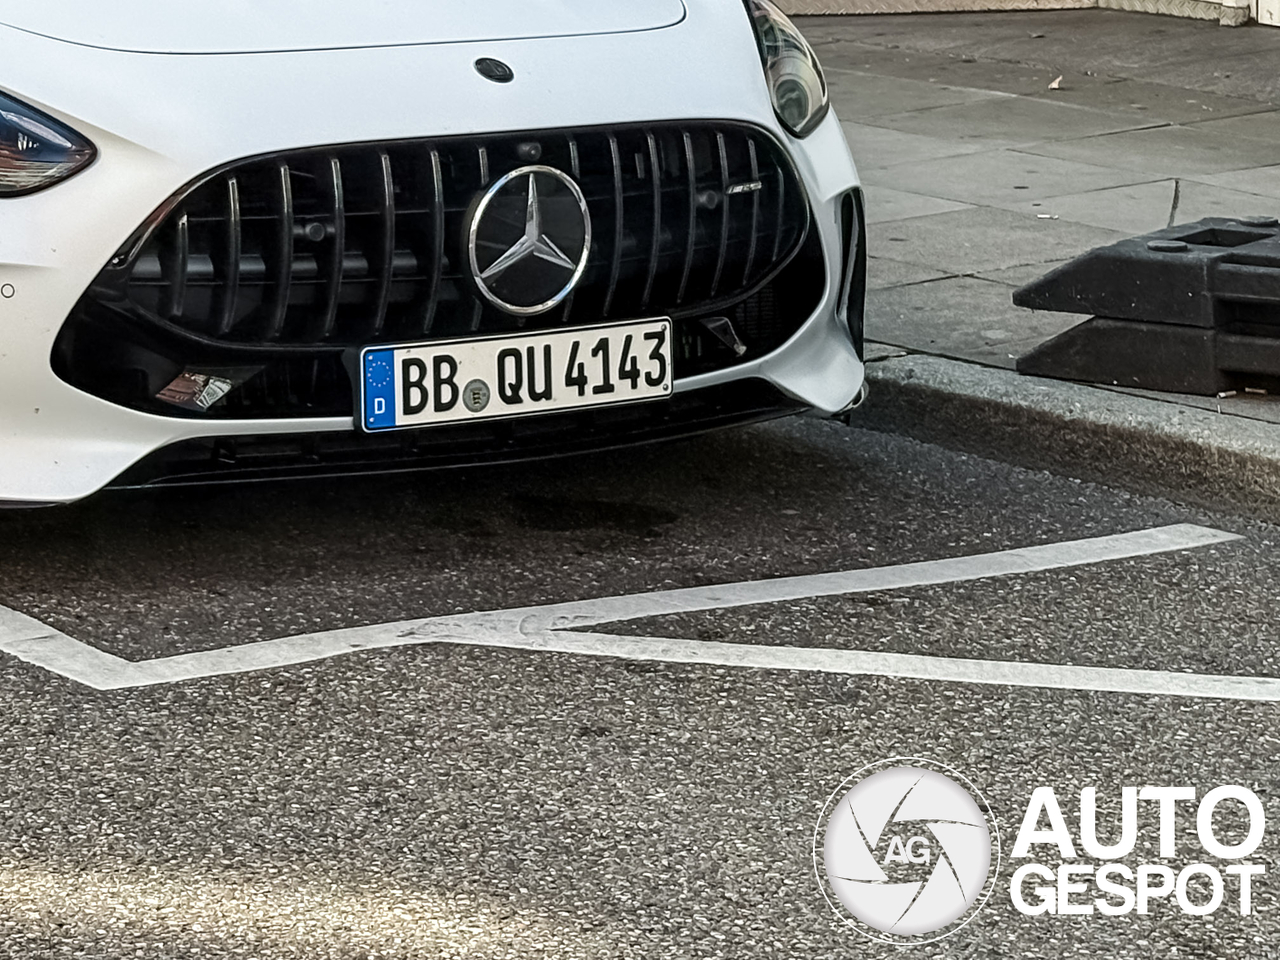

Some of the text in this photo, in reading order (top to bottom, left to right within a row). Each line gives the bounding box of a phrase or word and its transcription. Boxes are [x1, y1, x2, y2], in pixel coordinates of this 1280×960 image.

[401, 330, 667, 416] BB QU 4143
[374, 398, 385, 414] D
